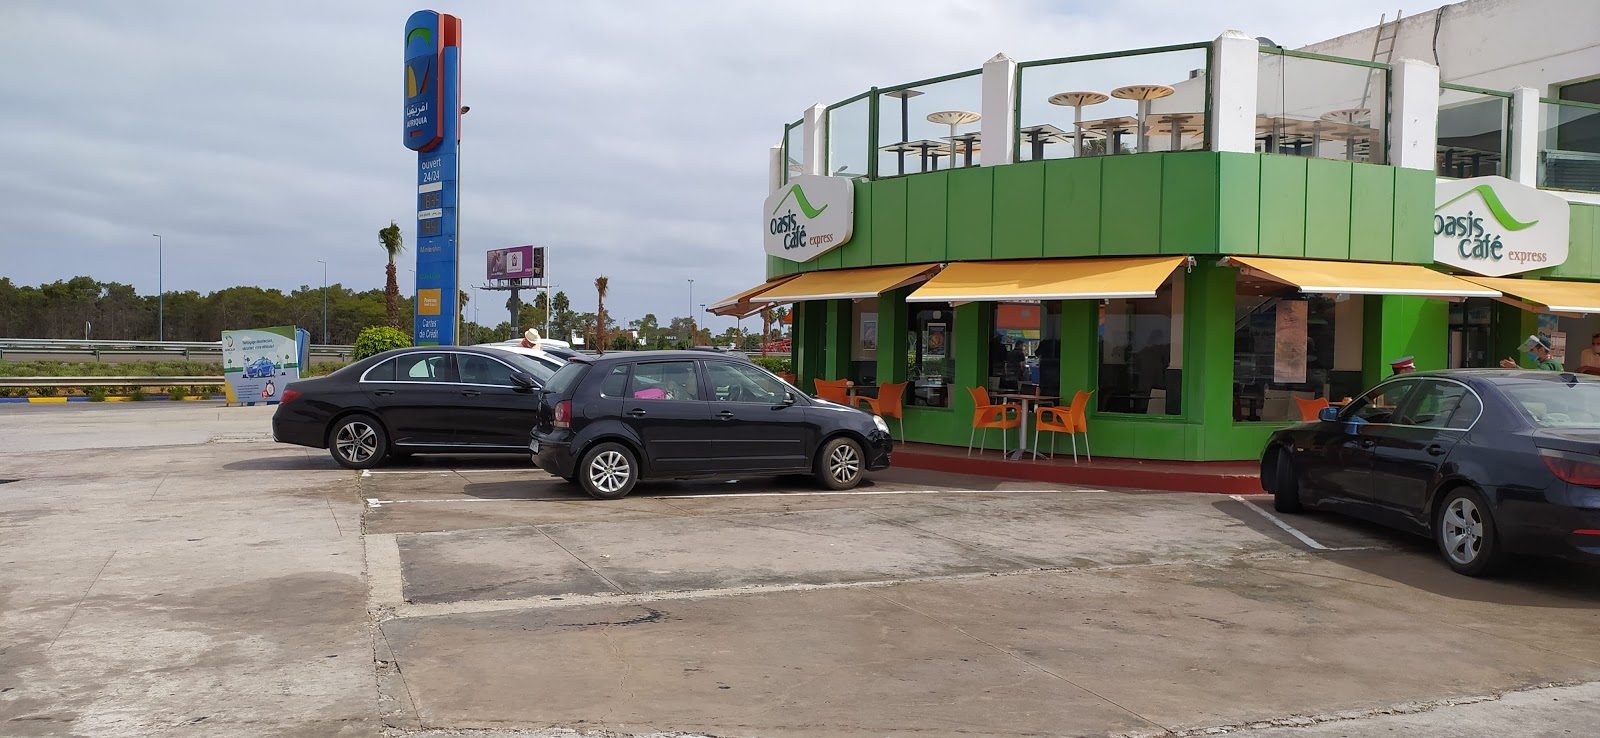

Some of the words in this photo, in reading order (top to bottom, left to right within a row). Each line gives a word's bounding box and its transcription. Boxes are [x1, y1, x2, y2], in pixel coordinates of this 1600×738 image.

[421, 158, 442, 170] ouvert
[423, 171, 440, 182] 24/24
[784, 225, 806, 250] café
[809, 233, 833, 247] express
[1458, 234, 1503, 260] café
[1508, 250, 1547, 264] express
